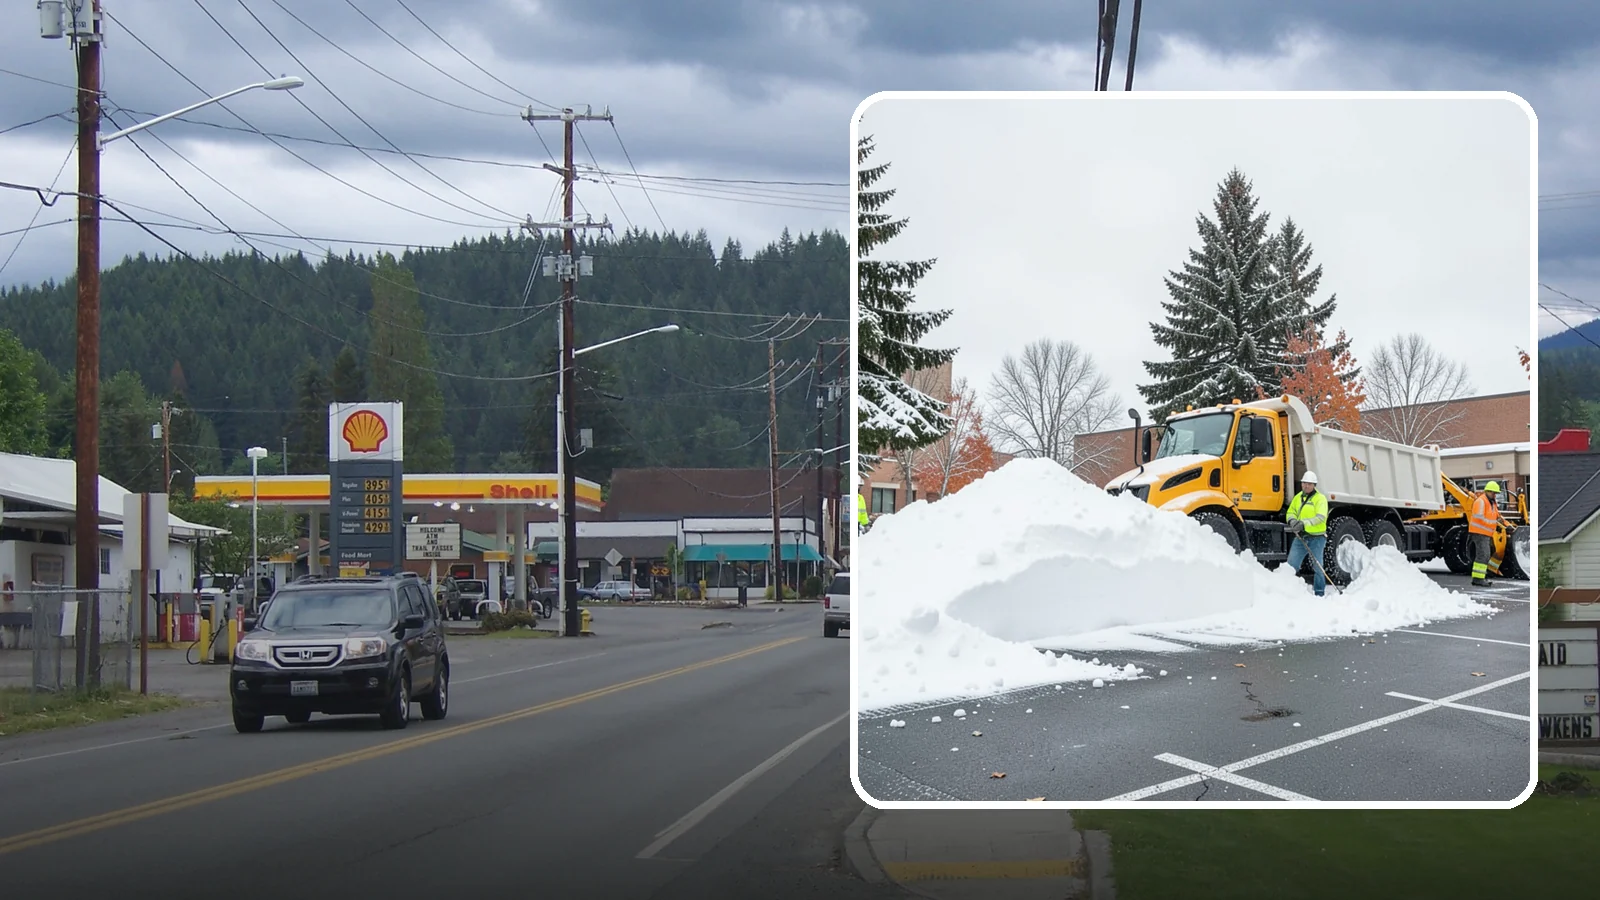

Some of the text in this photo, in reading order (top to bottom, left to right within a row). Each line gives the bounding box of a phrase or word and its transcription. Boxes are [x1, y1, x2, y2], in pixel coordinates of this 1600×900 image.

[365, 480, 383, 490] 395
[490, 484, 547, 498] Shell
[365, 494, 383, 504] 405
[365, 508, 383, 518] 415
[365, 522, 383, 532] 429
